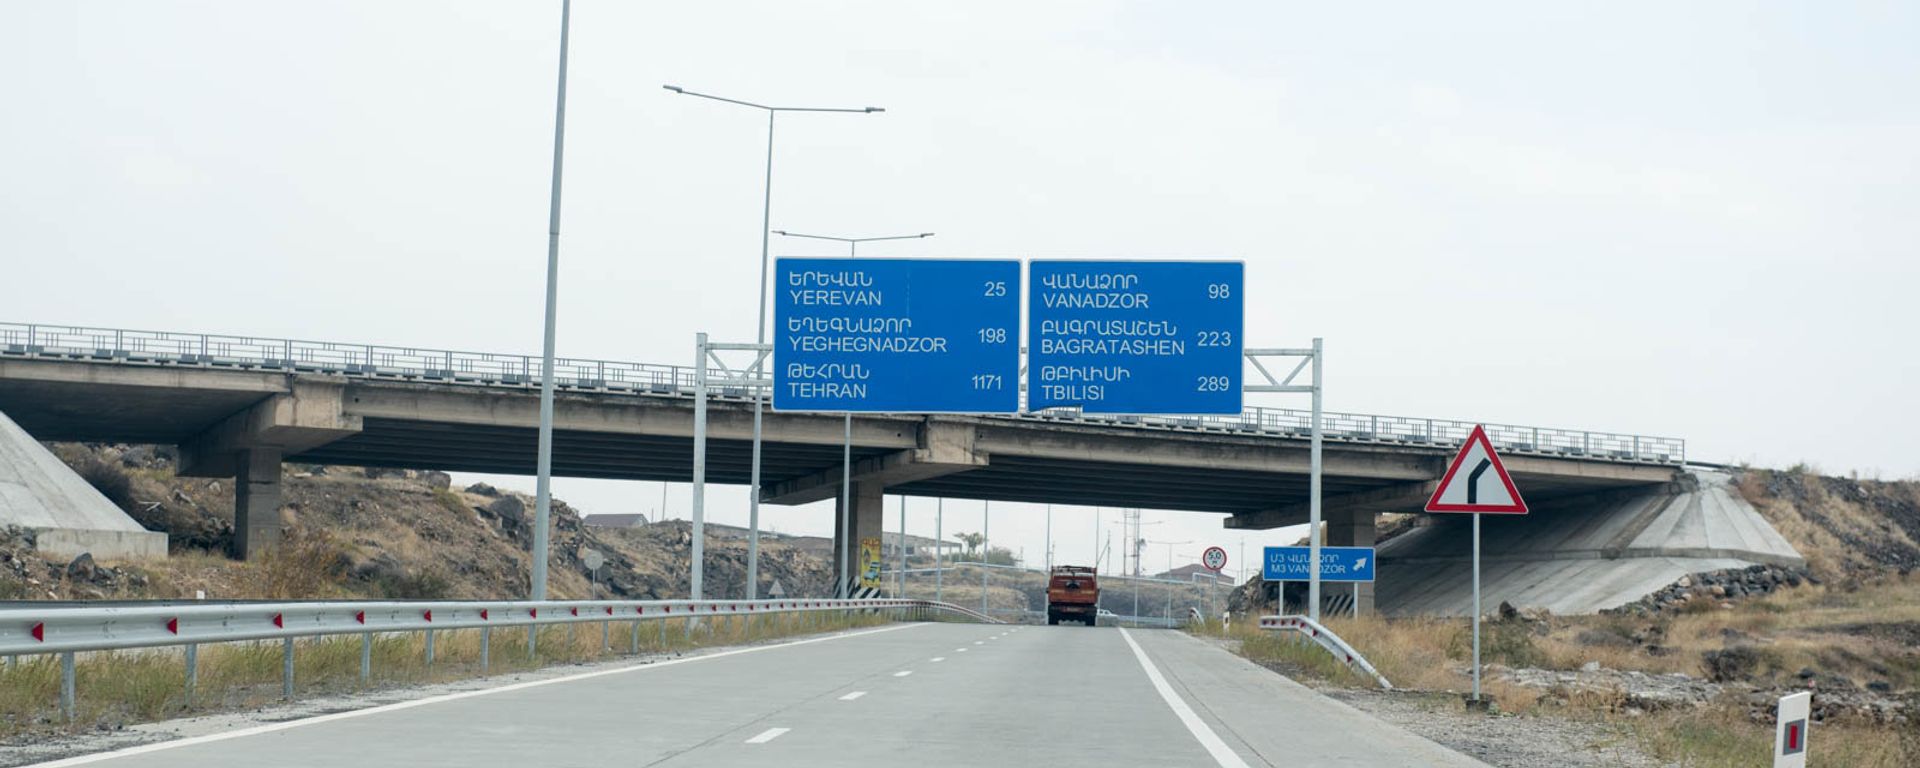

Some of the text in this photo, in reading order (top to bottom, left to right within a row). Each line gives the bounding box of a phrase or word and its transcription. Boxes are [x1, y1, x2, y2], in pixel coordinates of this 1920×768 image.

[789, 271, 873, 287] ԵՐԵՎԱՆ
[1042, 273, 1138, 290] ՎԱՆԱՁՈՐ
[790, 289, 882, 306] YEREVAN
[984, 281, 1006, 297] 25
[1208, 283, 1230, 299] 98
[1042, 292, 1149, 309] VANADZOR
[788, 316, 912, 333] ԵՂԵԳՆԱՁՈՐ
[1041, 319, 1177, 336] ԲԱԳՐԱՏԱՇԵՆ
[789, 335, 947, 353] YEGHEGNADZOR
[978, 327, 1006, 344] 198
[1197, 331, 1232, 347] 223
[1041, 338, 1185, 355] BAGRATASHEN
[787, 363, 870, 379] ԹԵՀՐԱՆ
[1041, 365, 1130, 382] ԹԲԻԼԻՍԻ
[787, 382, 867, 399] TEHRAN
[971, 374, 1002, 390] 1171
[1198, 376, 1229, 392] 289
[1041, 385, 1104, 401] TBILISI
[1271, 563, 1287, 573] M3
